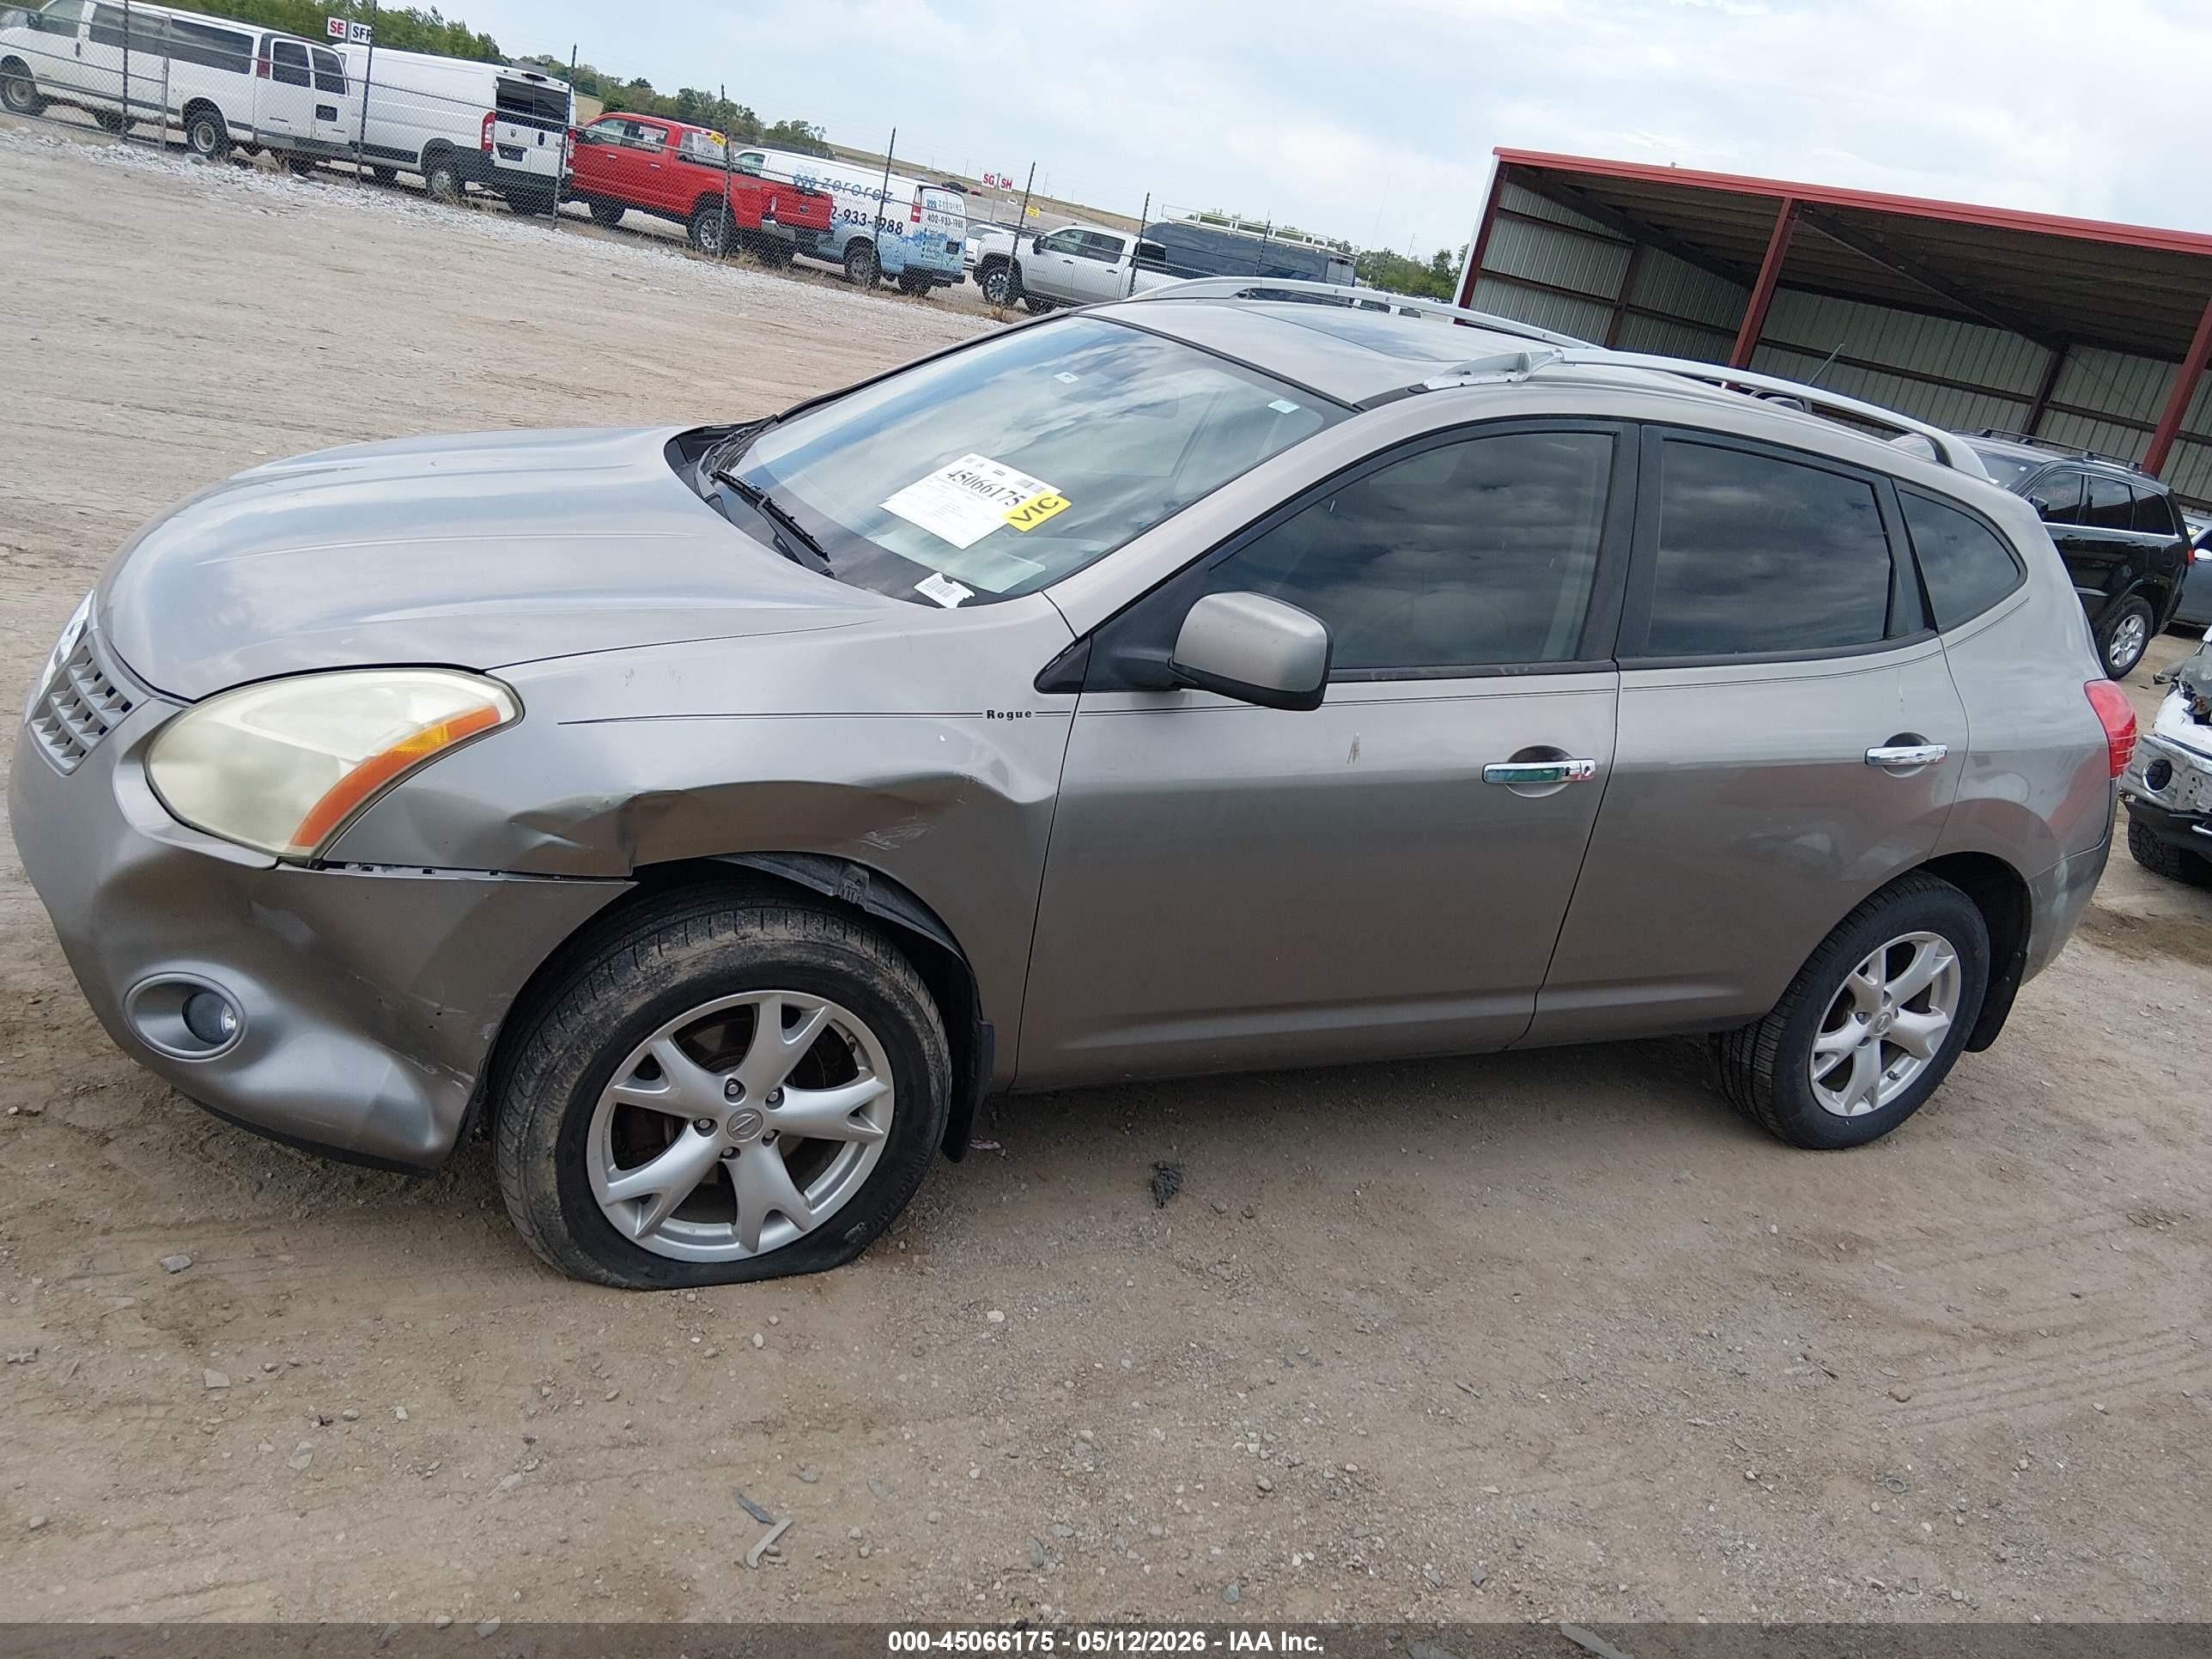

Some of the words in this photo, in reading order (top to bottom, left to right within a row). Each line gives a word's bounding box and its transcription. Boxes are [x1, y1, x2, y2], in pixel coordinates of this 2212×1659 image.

[330, 21, 343, 34] SE
[983, 173, 994, 185] SG
[1000, 178, 1012, 190] SH
[821, 177, 894, 204] zerorez
[947, 470, 1028, 507] 45066175
[1010, 497, 1060, 522] VIC
[987, 709, 1031, 720] Rogue
